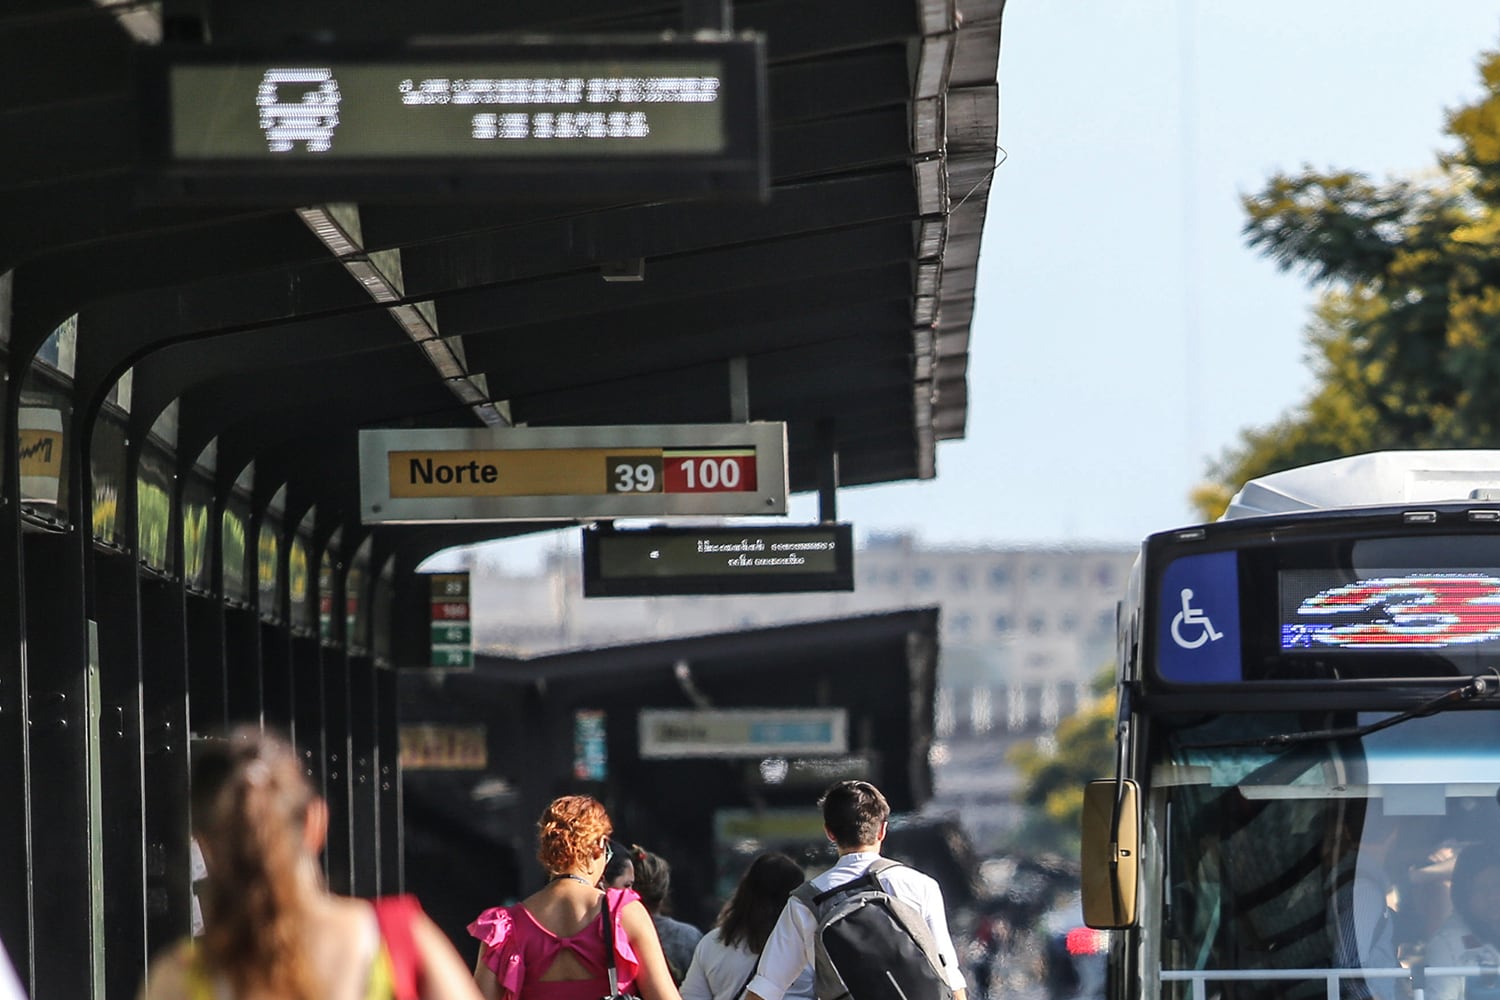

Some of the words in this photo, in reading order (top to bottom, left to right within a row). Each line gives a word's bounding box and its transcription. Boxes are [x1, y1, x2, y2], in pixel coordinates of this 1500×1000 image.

[410, 458, 498, 485] Norte
[614, 463, 655, 492] 39
[680, 458, 740, 489] 100
